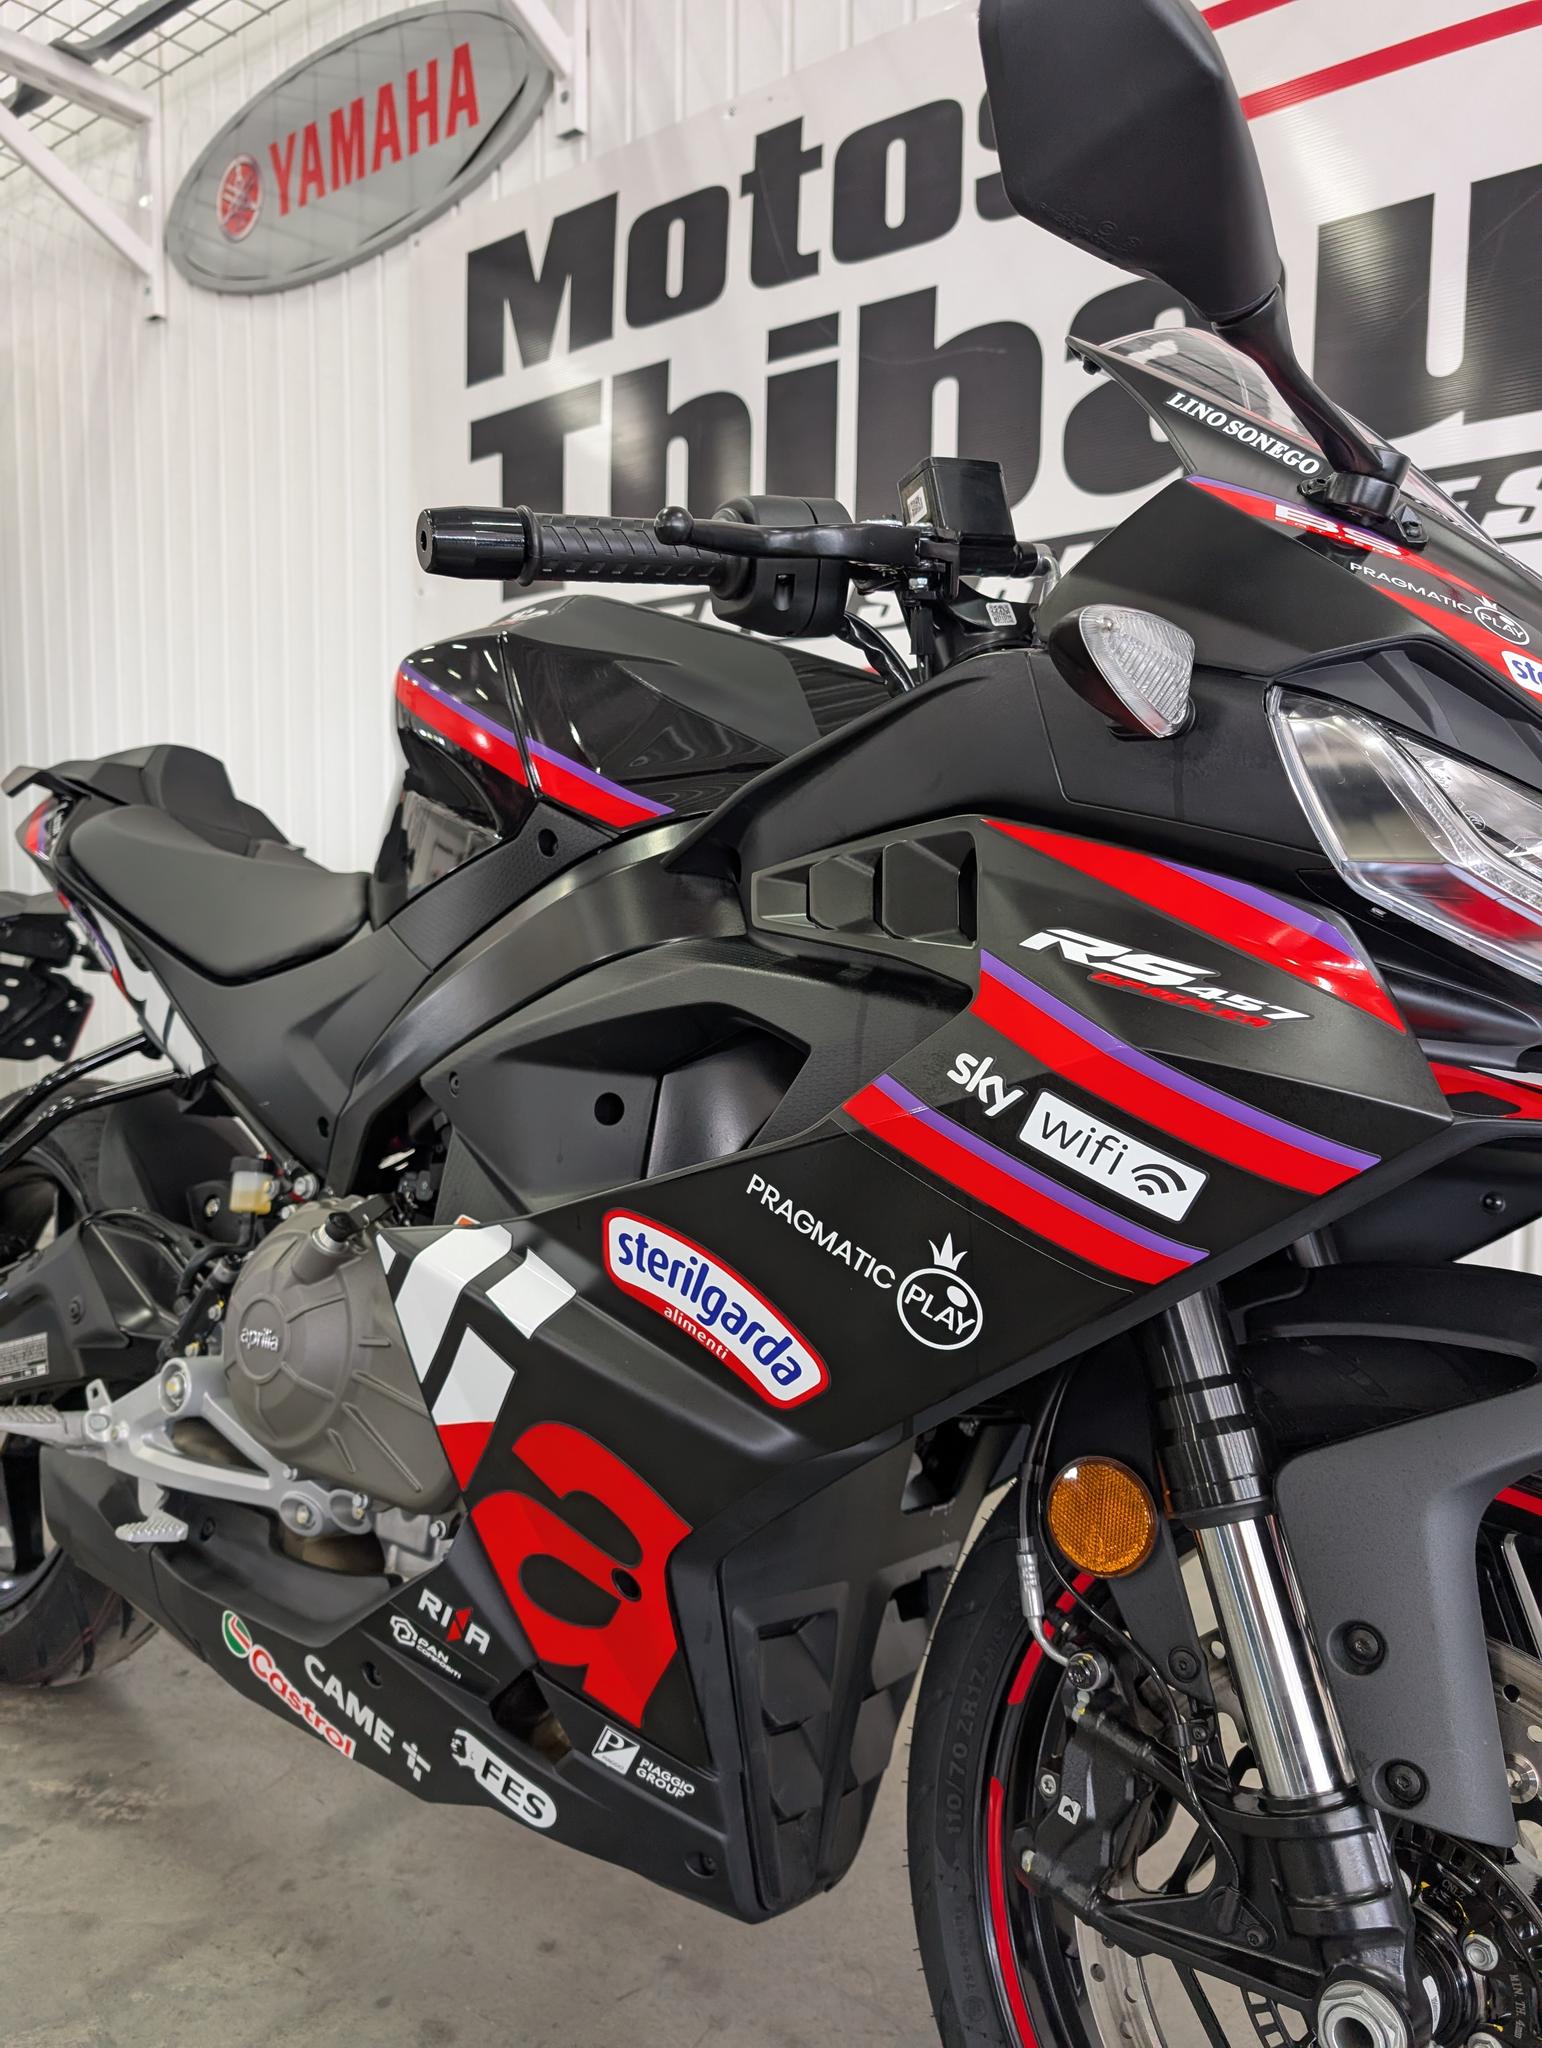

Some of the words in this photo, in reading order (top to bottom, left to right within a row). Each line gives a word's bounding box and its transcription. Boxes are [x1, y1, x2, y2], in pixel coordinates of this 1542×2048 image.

[268, 42, 480, 216] YAMAHA
[1166, 392, 1227, 427] LINO
[1222, 420, 1320, 474] SONEGO
[1350, 562, 1474, 614] PRAGMATIC
[1480, 612, 1524, 639] PLAY
[1019, 929, 1216, 986] RS
[1176, 987, 1310, 1020] 457
[946, 1053, 1025, 1117] sky
[1041, 1111, 1129, 1175] wifi
[745, 1174, 896, 1289] PRAGMATIC
[903, 1284, 976, 1336] PLAY
[240, 1327, 279, 1352] aprilia
[618, 1232, 802, 1386] sterilgarda
[663, 1305, 729, 1361] alimenti
[418, 1637, 449, 1664] PAN
[250, 1645, 356, 1759] Castrol
[304, 1654, 395, 1755] CAME
[481, 1757, 546, 1820] FES
[635, 1767, 686, 1799] GROUP
[638, 1757, 696, 1795] PIAGGIO
